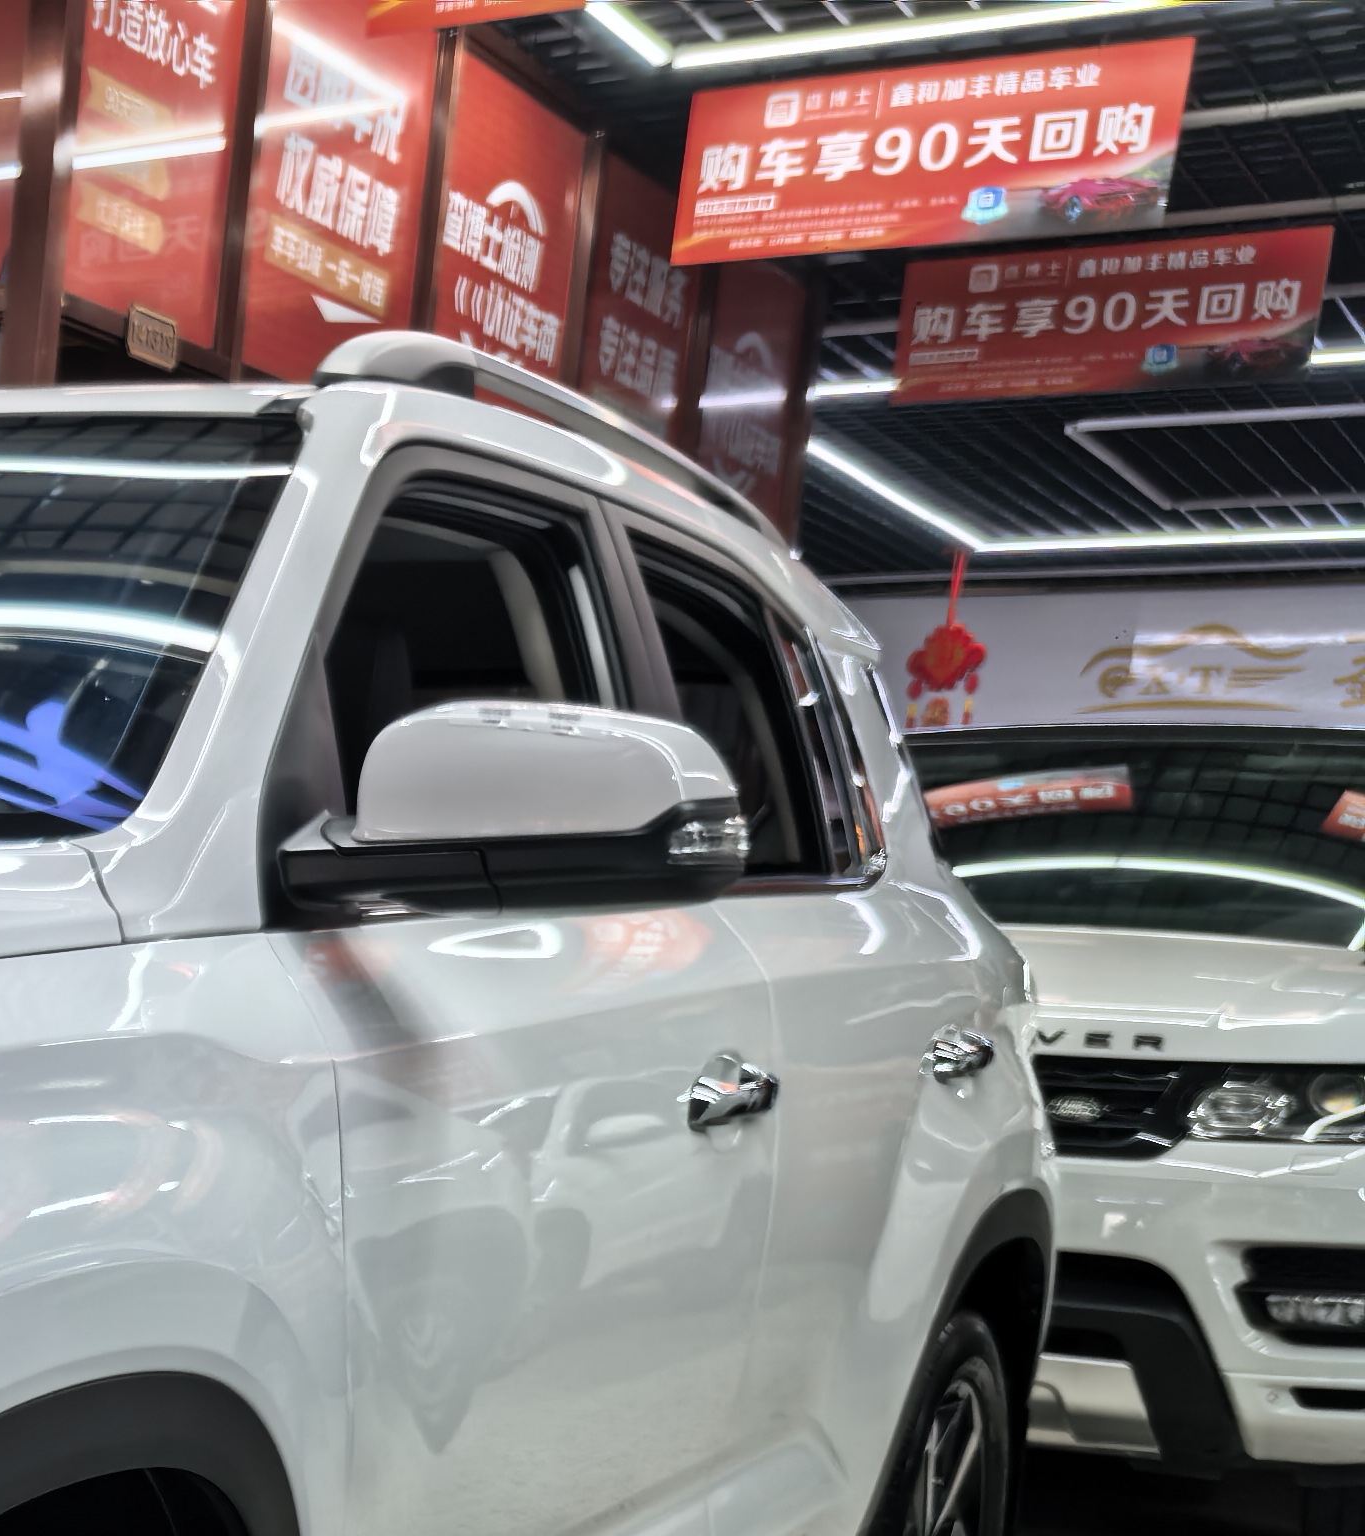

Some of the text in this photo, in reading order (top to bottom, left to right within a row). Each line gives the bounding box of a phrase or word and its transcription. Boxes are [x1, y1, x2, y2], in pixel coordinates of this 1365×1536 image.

[275, 132, 399, 257] 权威保障
[696, 102, 1156, 196] 购车享90天回购
[443, 189, 544, 294] 查博士检测
[911, 277, 1302, 347] 购车享90天回购
